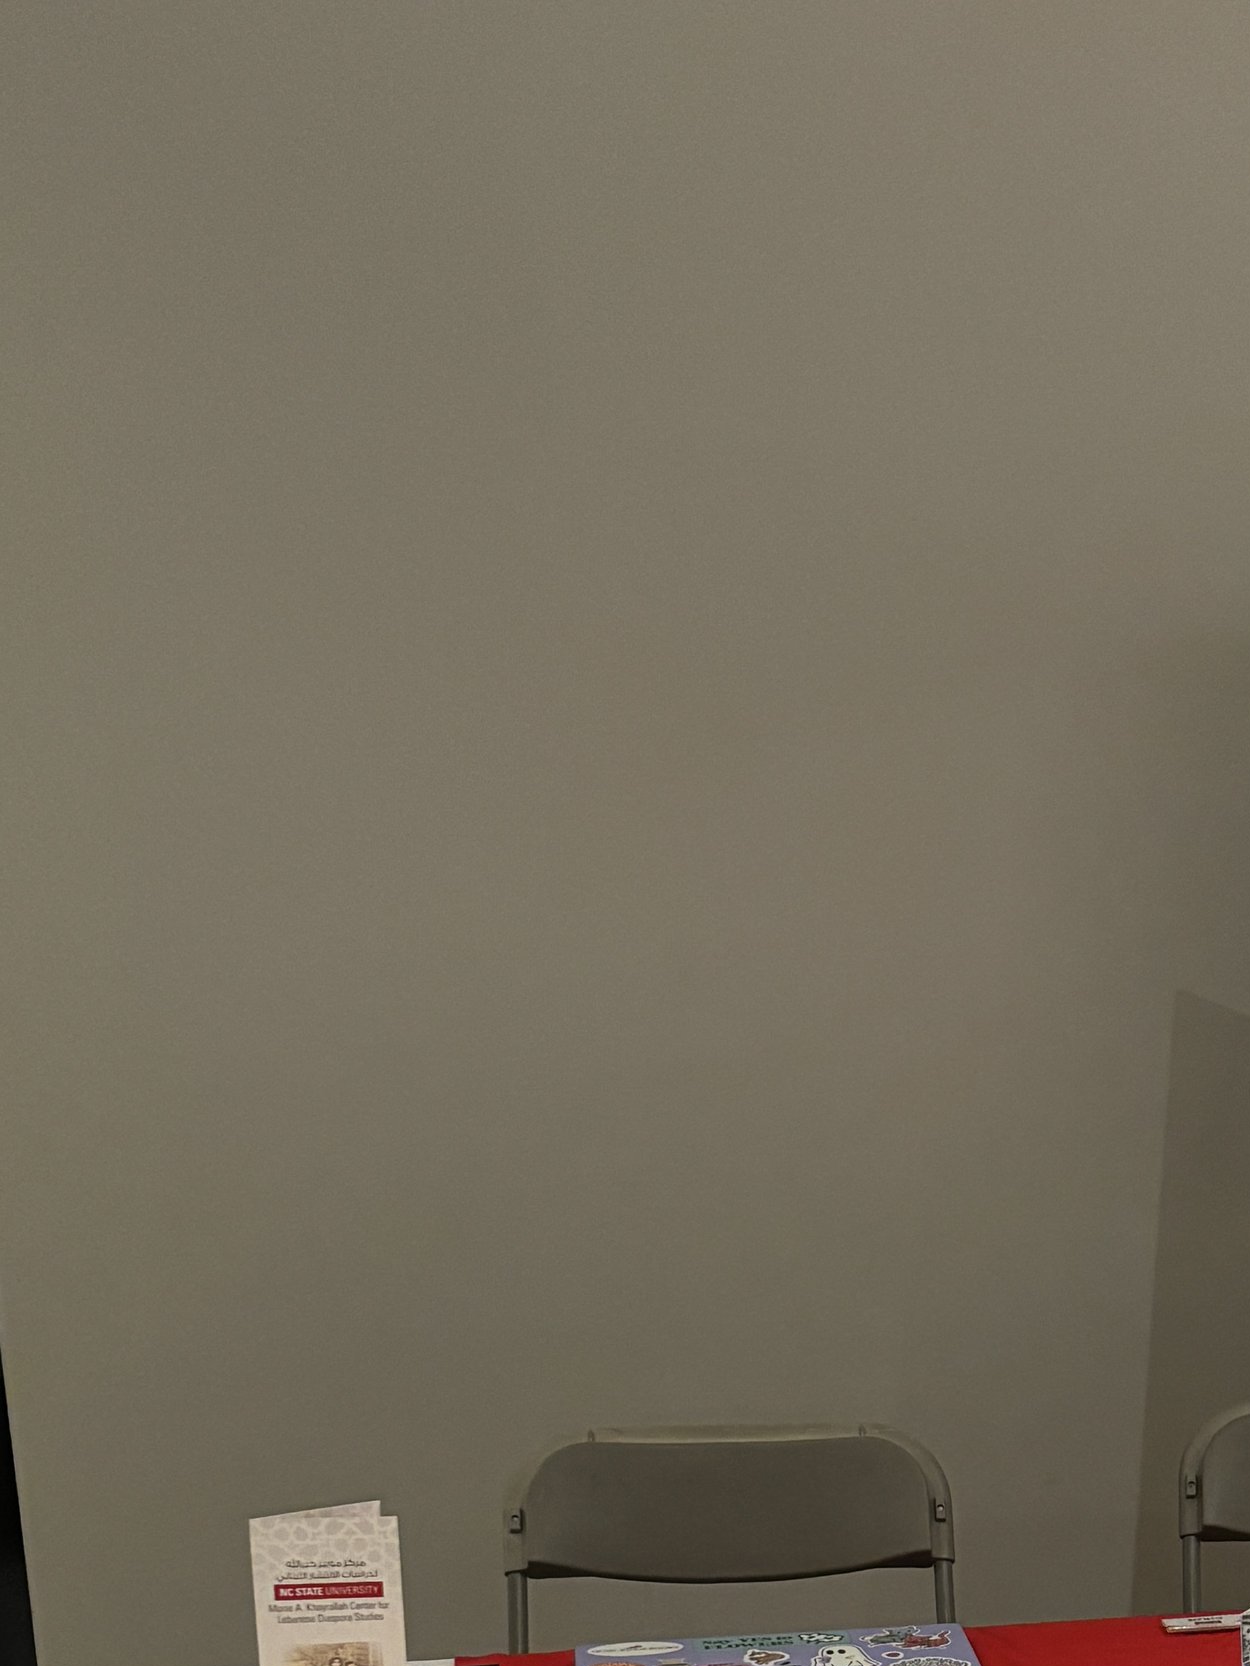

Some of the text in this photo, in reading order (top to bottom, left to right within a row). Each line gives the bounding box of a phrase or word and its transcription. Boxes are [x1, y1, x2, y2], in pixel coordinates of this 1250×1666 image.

[280, 1585, 379, 1596] NC STATE UNIVERSITY
[350, 1601, 376, 1610] Center
[354, 1612, 384, 1621] Studies
